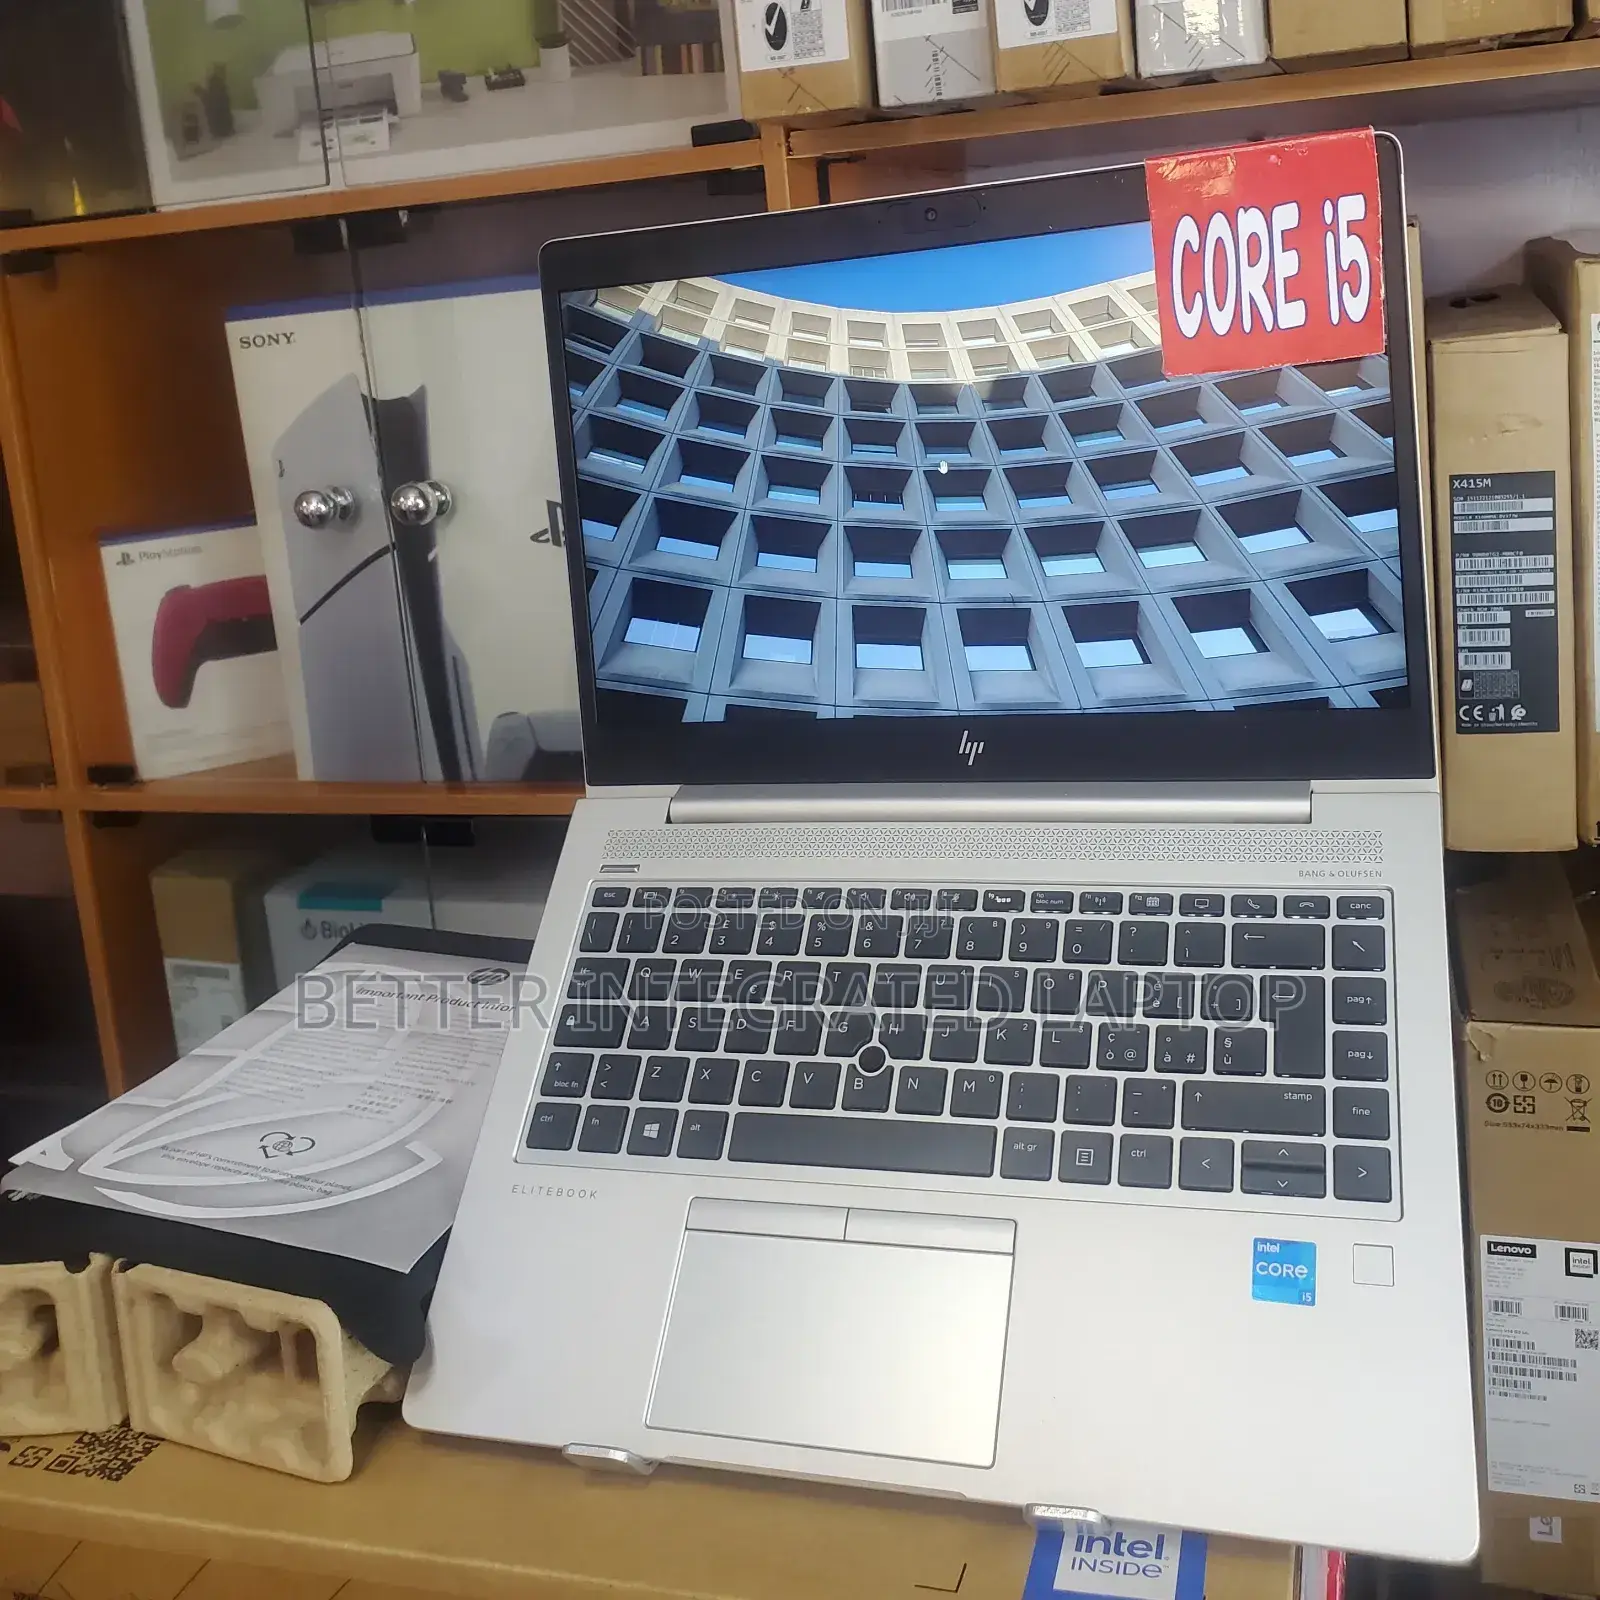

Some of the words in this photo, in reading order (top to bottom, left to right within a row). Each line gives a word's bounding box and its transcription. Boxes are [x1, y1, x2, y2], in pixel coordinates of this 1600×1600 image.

[1171, 201, 1306, 338] CORE
[1322, 193, 1370, 327] i5
[239, 332, 295, 349] SONY
[1452, 478, 1492, 489] X415M
[959, 730, 985, 766] hp
[1299, 870, 1326, 878] BANG
[1329, 870, 1335, 878] &
[1337, 870, 1382, 878] OLUFSEN
[1350, 902, 1371, 910] canc
[817, 921, 827, 931] %
[866, 921, 874, 931] &
[1130, 926, 1137, 937] ?
[671, 936, 679, 945] 2
[718, 936, 726, 946] 3
[765, 936, 774, 946] 4
[814, 937, 822, 947] 5
[864, 938, 872, 948] 6
[915, 940, 922, 949] 7
[966, 941, 974, 951] 8
[1019, 942, 1027, 952] 9
[641, 967, 651, 978] Q
[688, 968, 702, 979] W
[734, 969, 744, 980] E
[783, 971, 793, 981] R
[833, 972, 841, 982] T
[884, 973, 894, 984] Y
[936, 975, 945, 985] U
[1098, 980, 1107, 992] P
[356, 986, 424, 1001] Important
[425, 995, 482, 1009] Product
[640, 1016, 650, 1026] A
[688, 1017, 697, 1028] S
[736, 1018, 746, 1030] D
[786, 1020, 796, 1030] F
[838, 1022, 848, 1033] G
[889, 1024, 899, 1034] H
[942, 1026, 950, 1038] J
[996, 1028, 1007, 1040] K
[1052, 1032, 1060, 1043] L
[1124, 1049, 1136, 1061] @
[1186, 1053, 1196, 1064] #
[651, 1066, 662, 1078] Z
[700, 1068, 712, 1080] X
[751, 1070, 762, 1082] C
[804, 1072, 814, 1084] V
[554, 1080, 570, 1088] bloc
[854, 1078, 864, 1090] B
[908, 1078, 919, 1090] N
[963, 1080, 976, 1092] M
[1284, 1092, 1312, 1102] stamp
[1352, 1106, 1371, 1116] fine
[540, 1114, 554, 1122] ctrl
[591, 1118, 600, 1126] fn
[690, 1124, 701, 1132] alt
[1014, 1142, 1024, 1150] alt
[1026, 1144, 1038, 1152] gr
[1131, 1149, 1146, 1158] ctrl
[512, 1184, 598, 1199] ELITEBOOK
[1257, 1242, 1280, 1254] intel
[1490, 1243, 1532, 1255] Lenovo
[1572, 1257, 1590, 1265] intel
[1302, 1292, 1312, 1302] i5
[1074, 1531, 1165, 1560] intel
